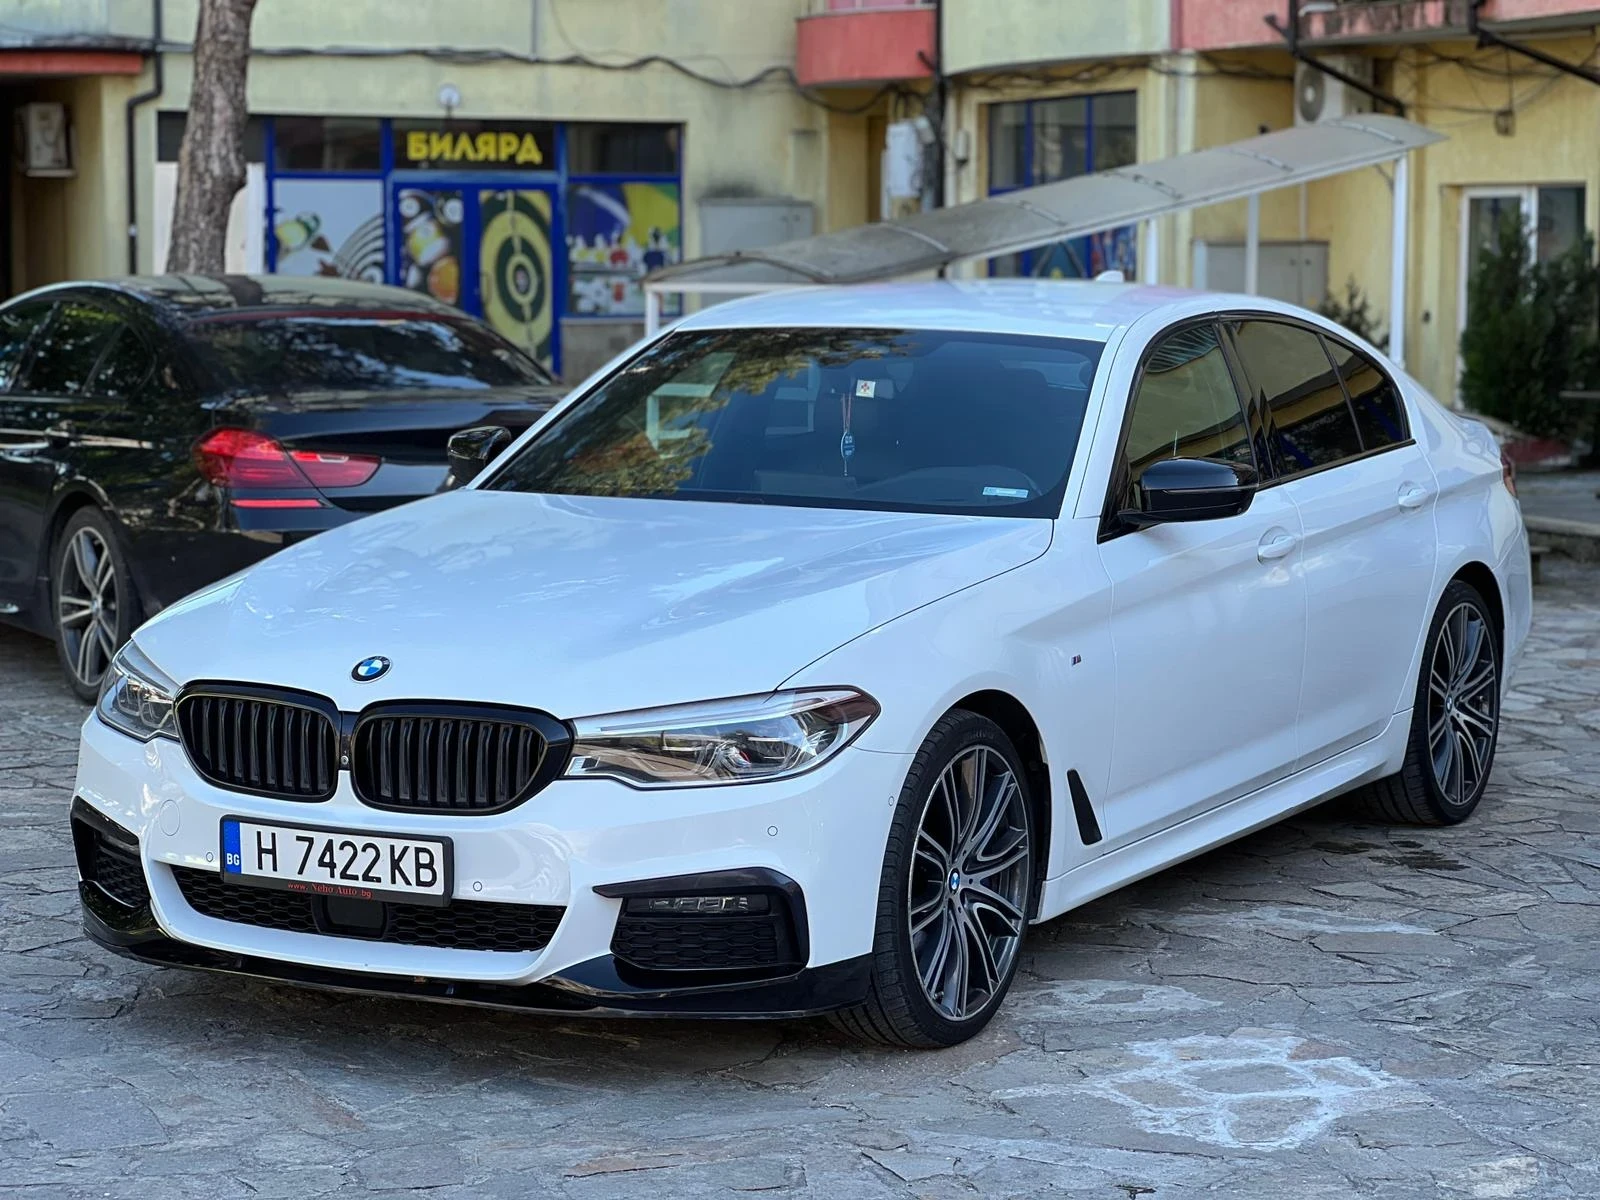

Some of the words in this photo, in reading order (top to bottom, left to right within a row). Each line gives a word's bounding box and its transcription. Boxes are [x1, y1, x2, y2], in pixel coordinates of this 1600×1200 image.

[407, 131, 543, 165] БИЛЯРД
[226, 852, 240, 866] BG
[256, 830, 278, 872] H
[295, 835, 382, 883] 7422
[389, 844, 438, 887] KB
[336, 886, 357, 896] Auto
